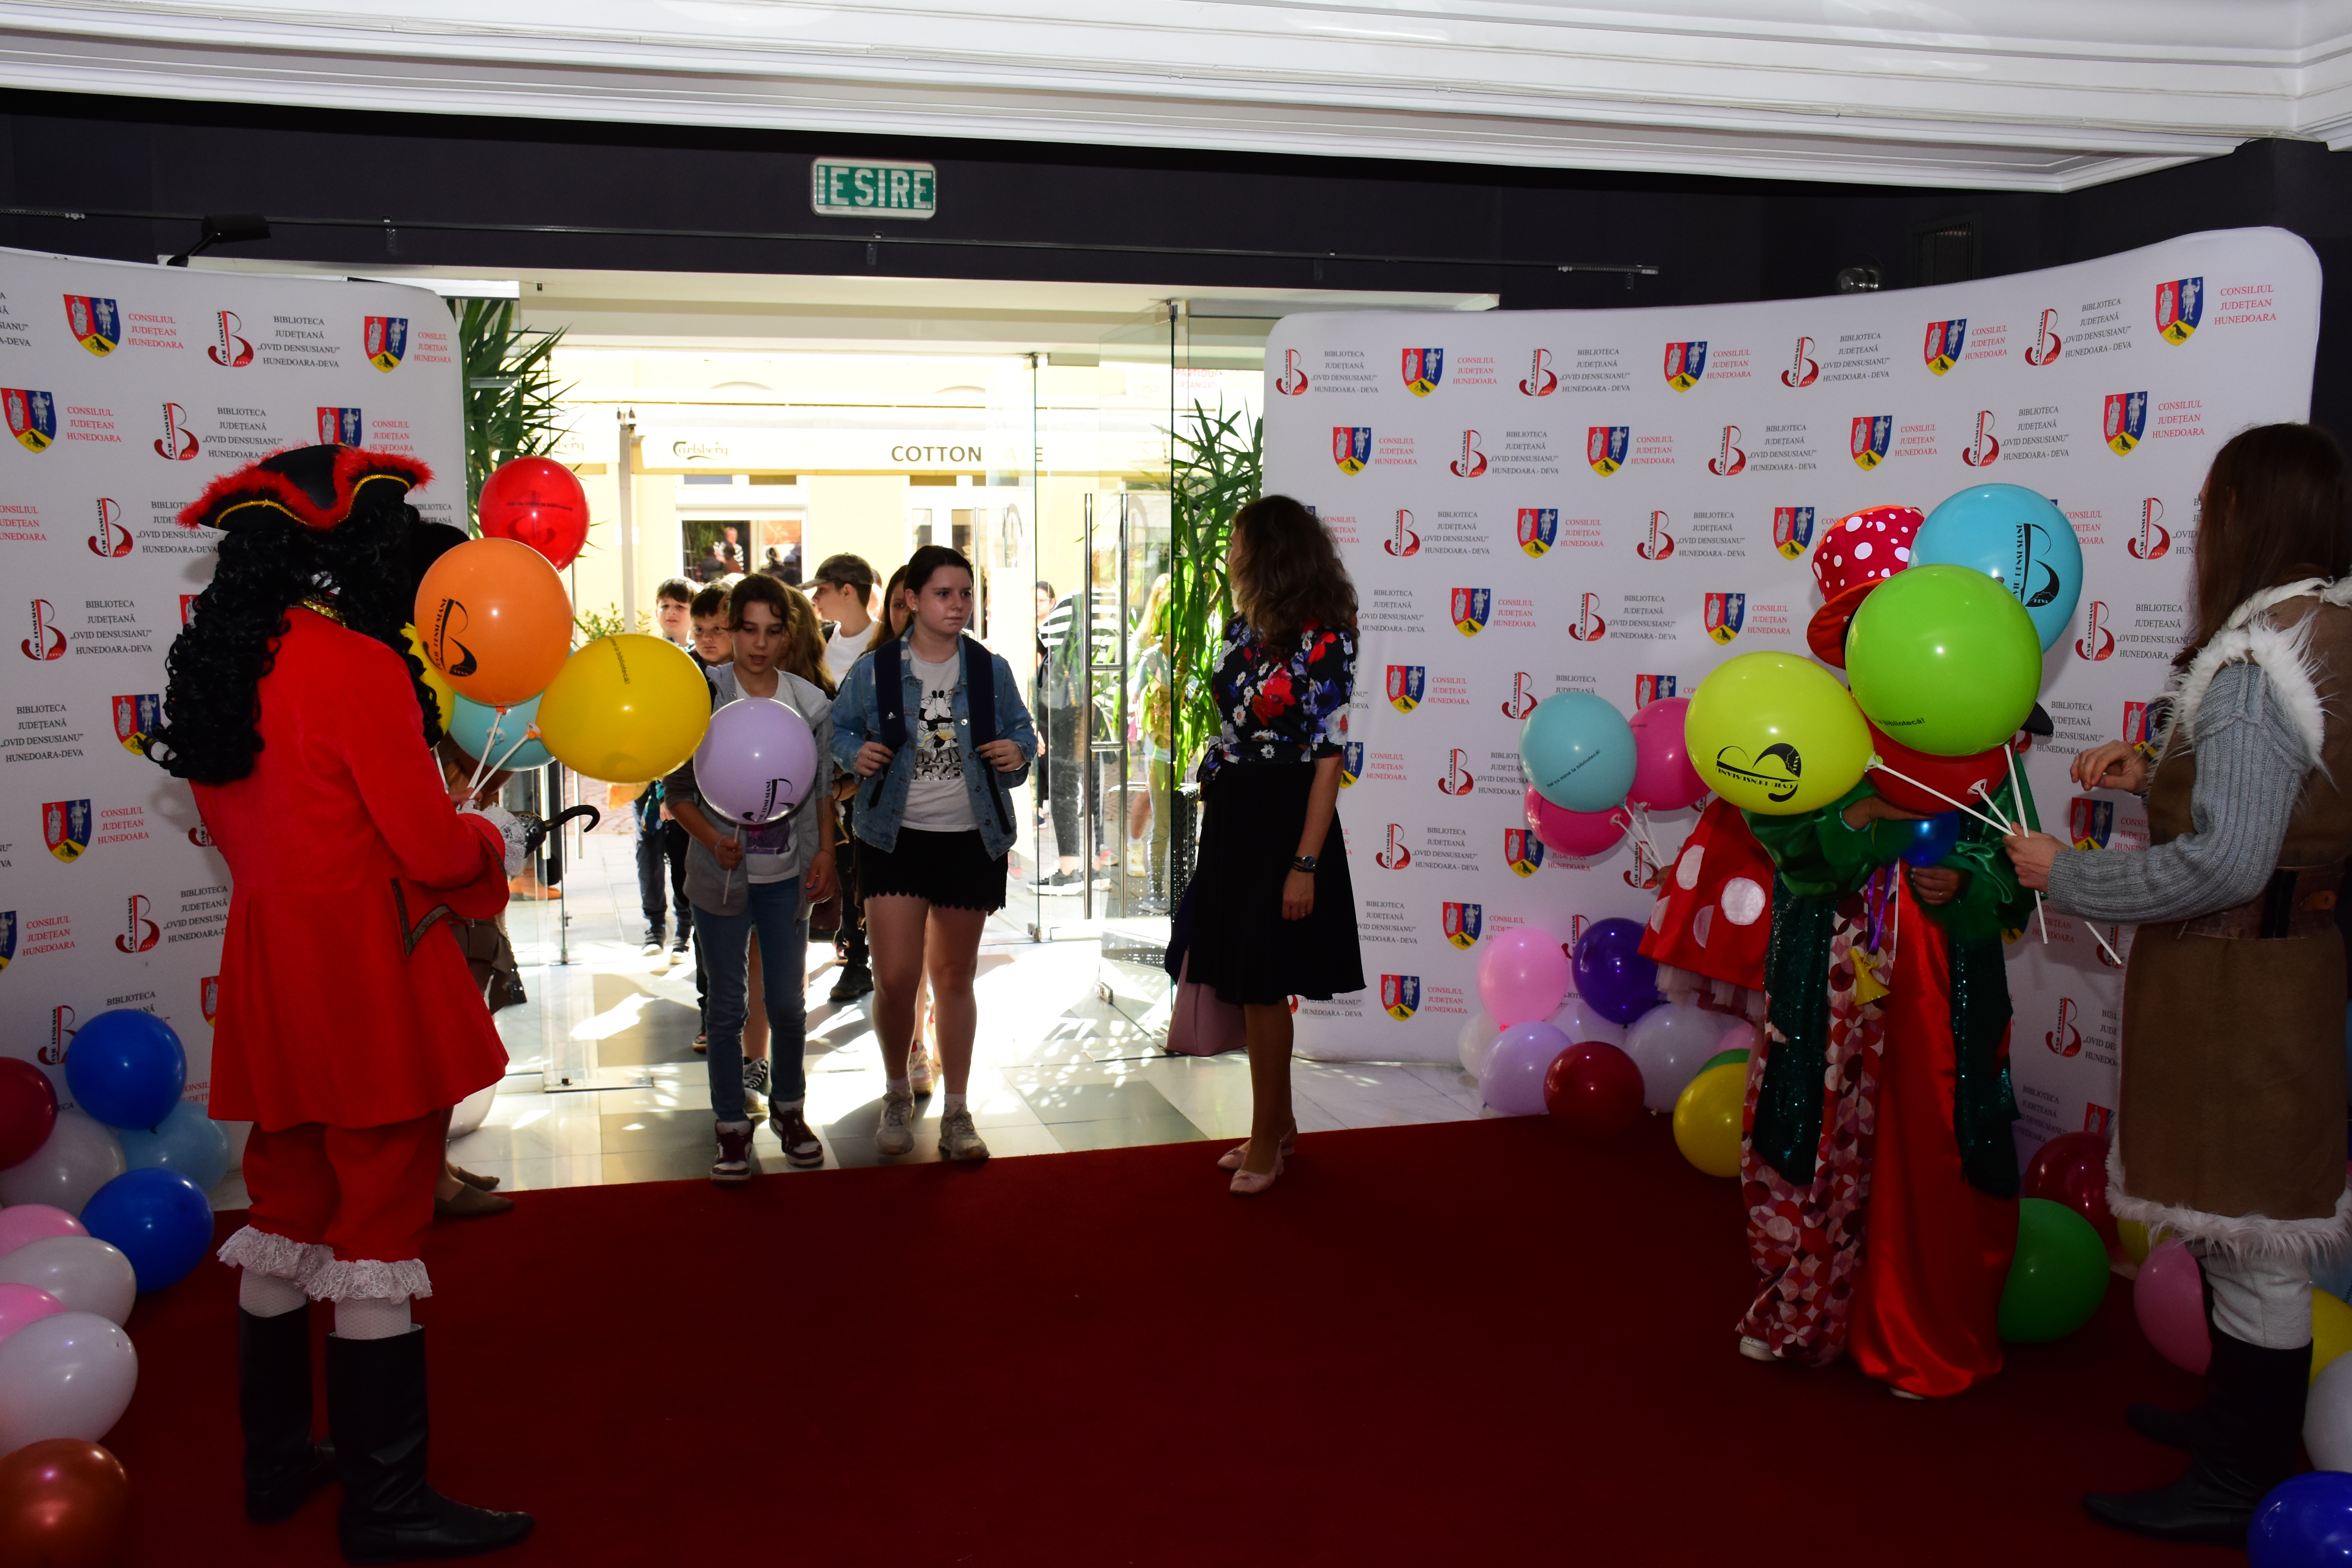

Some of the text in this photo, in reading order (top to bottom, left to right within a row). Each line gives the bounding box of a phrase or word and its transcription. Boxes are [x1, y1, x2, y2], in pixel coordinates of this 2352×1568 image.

[818, 166, 932, 209] IESIRE
[2220, 285, 2273, 296] CONSILIUL
[2082, 299, 2121, 312] BIBLIOTECA
[128, 314, 176, 324] CONSILIUL
[274, 316, 324, 325] BIBLIOTECA
[2215, 313, 2276, 325] HUNEDOARA
[1972, 325, 2007, 336] CONSILIUL
[1840, 333, 1880, 342] BIBLIOTECA
[128, 338, 183, 349] HUNEDOARA
[1965, 349, 2007, 359] HUNEDOARA
[2065, 345, 2107, 358] HUNEDOARA
[414, 354, 451, 363] HUNEDOARA
[2158, 400, 2202, 411] CONSILIUL
[67, 407, 113, 416] CONSILIUL
[218, 407, 266, 416] BIBLIOTECA
[2019, 407, 2058, 416] BIBLIOTECA
[67, 432, 122, 442] HUNEDOARA
[2152, 428, 2204, 438] HUNEDOARA
[673, 441, 728, 460] Carlsberg
[892, 446, 981, 462] COTTON
[2004, 451, 2046, 460] HUNEDOARA
[16, 704, 67, 714] BIBLIOTECA
[101, 807, 144, 818] CONSILIUL
[98, 832, 149, 844] HUNEDOARA
[181, 886, 228, 898] BIBLIOTECA
[26, 916, 71, 929] CONSILIUL
[23, 941, 75, 956] HUNEDOARA
[106, 991, 156, 1006] BIBLIOTECA
